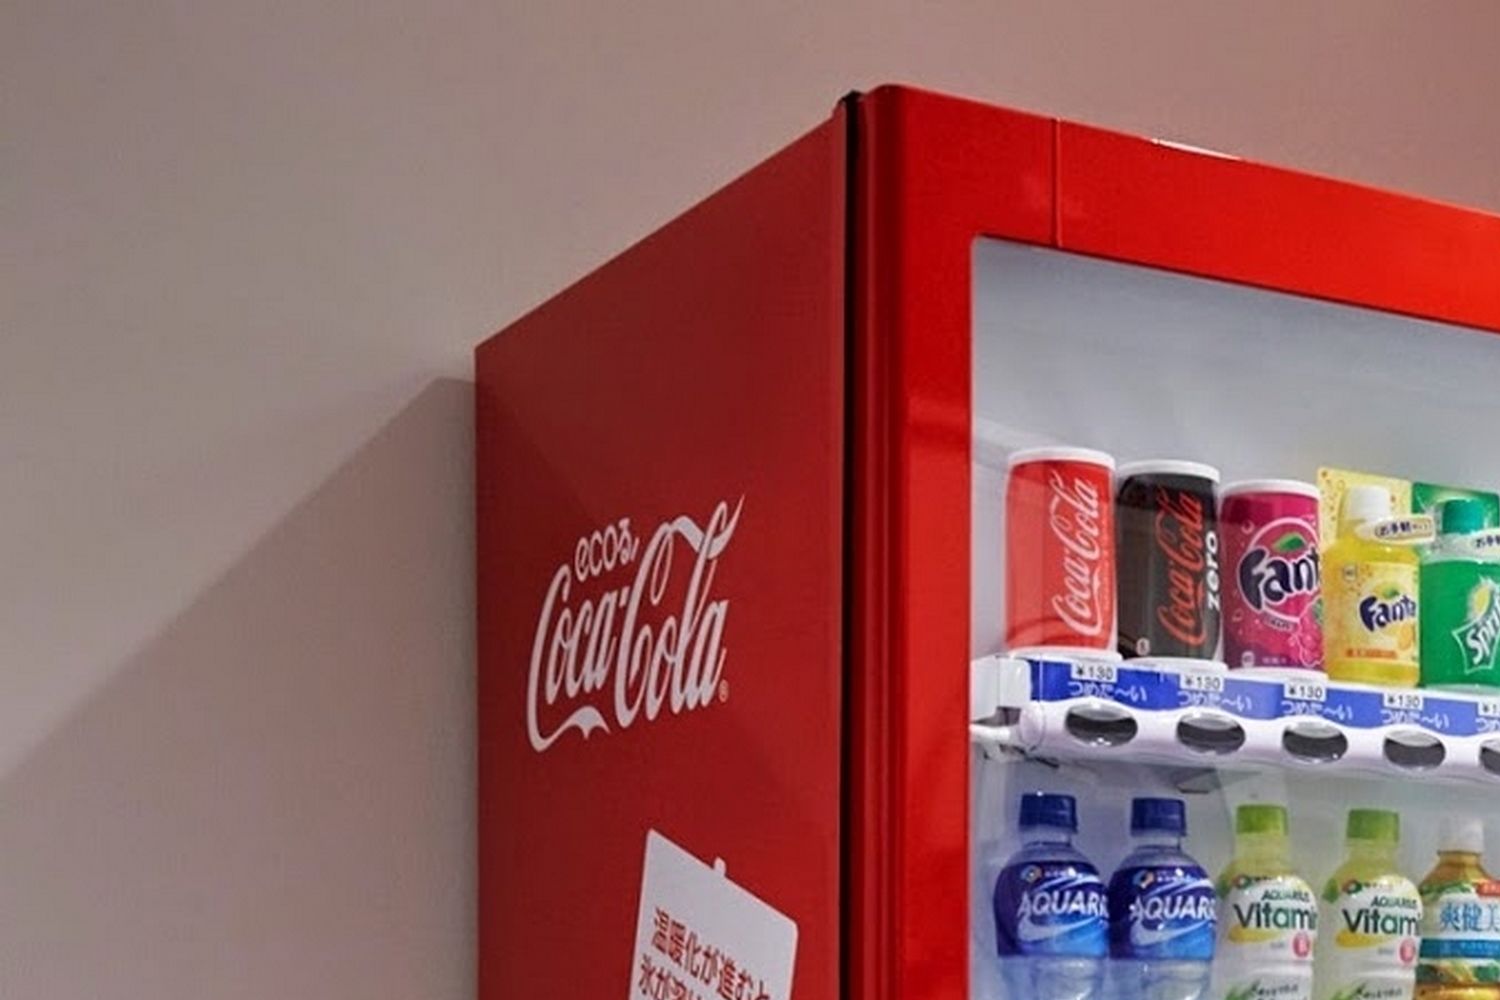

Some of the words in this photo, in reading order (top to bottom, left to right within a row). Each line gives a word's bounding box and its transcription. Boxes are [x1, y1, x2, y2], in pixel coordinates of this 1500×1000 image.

[1051, 470, 1100, 636] Coca-Cola
[1156, 485, 1207, 646] Coca-Cola
[1205, 531, 1220, 612] zero
[527, 493, 745, 752] Coca-Cola
[1076, 665, 1113, 679] ¥130
[1184, 675, 1220, 689] ¥130
[1289, 686, 1323, 699] ¥130
[1387, 695, 1420, 707] ¥130
